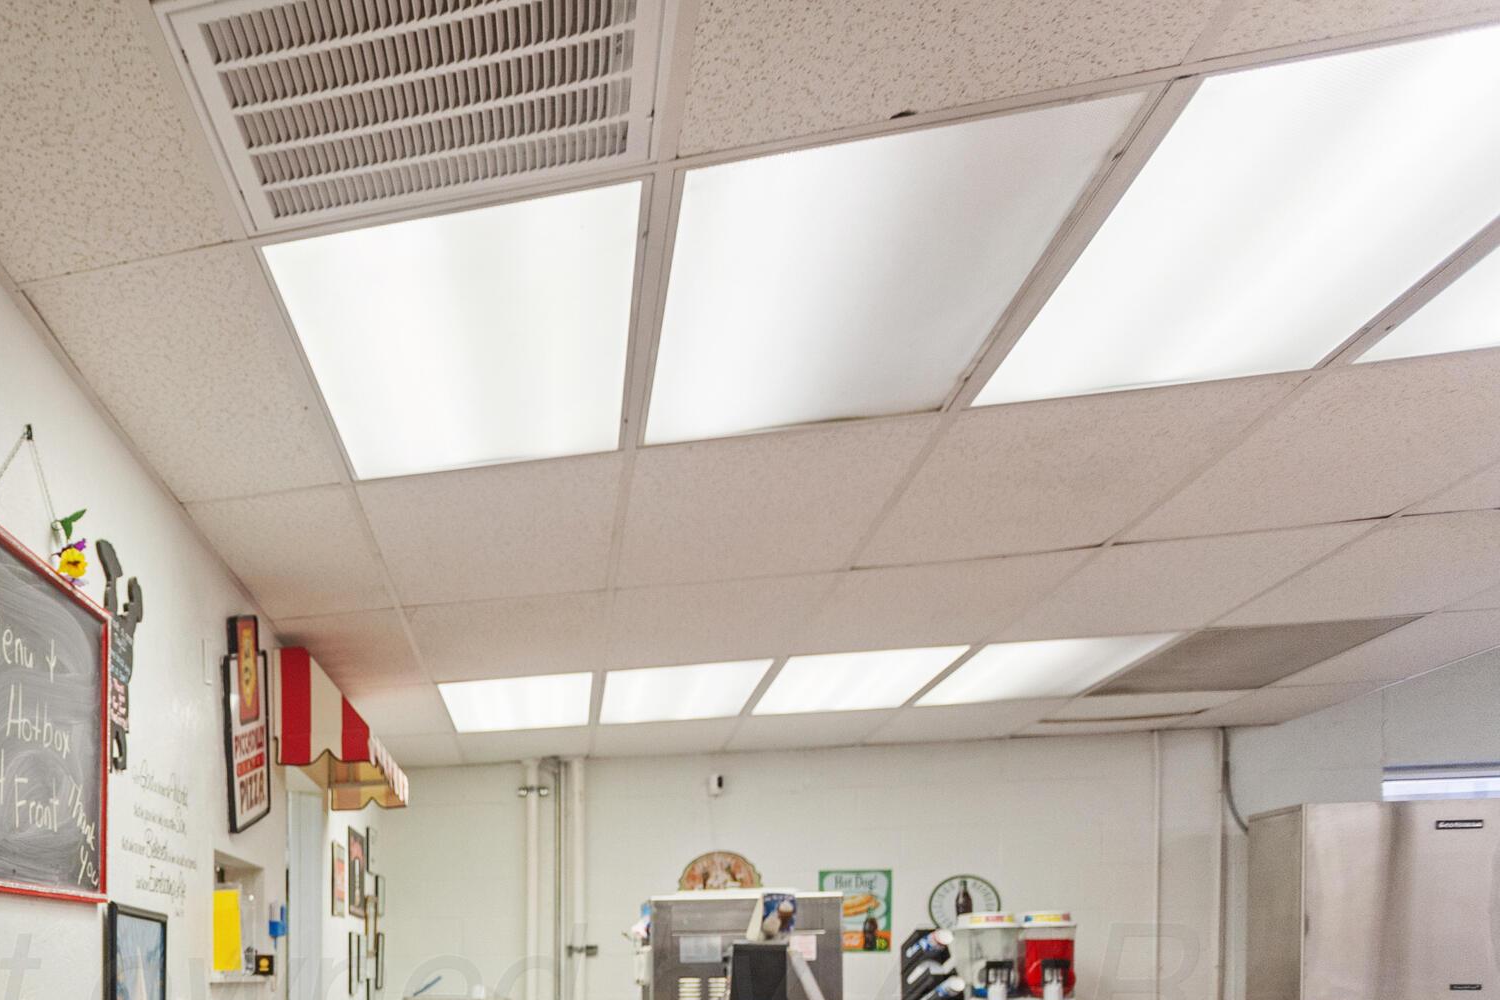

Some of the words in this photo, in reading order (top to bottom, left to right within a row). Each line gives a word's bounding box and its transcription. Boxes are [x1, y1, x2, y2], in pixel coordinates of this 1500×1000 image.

[6, 680, 72, 759] Hotbox
[14, 777, 61, 833] Front
[240, 769, 265, 815] PIZZA
